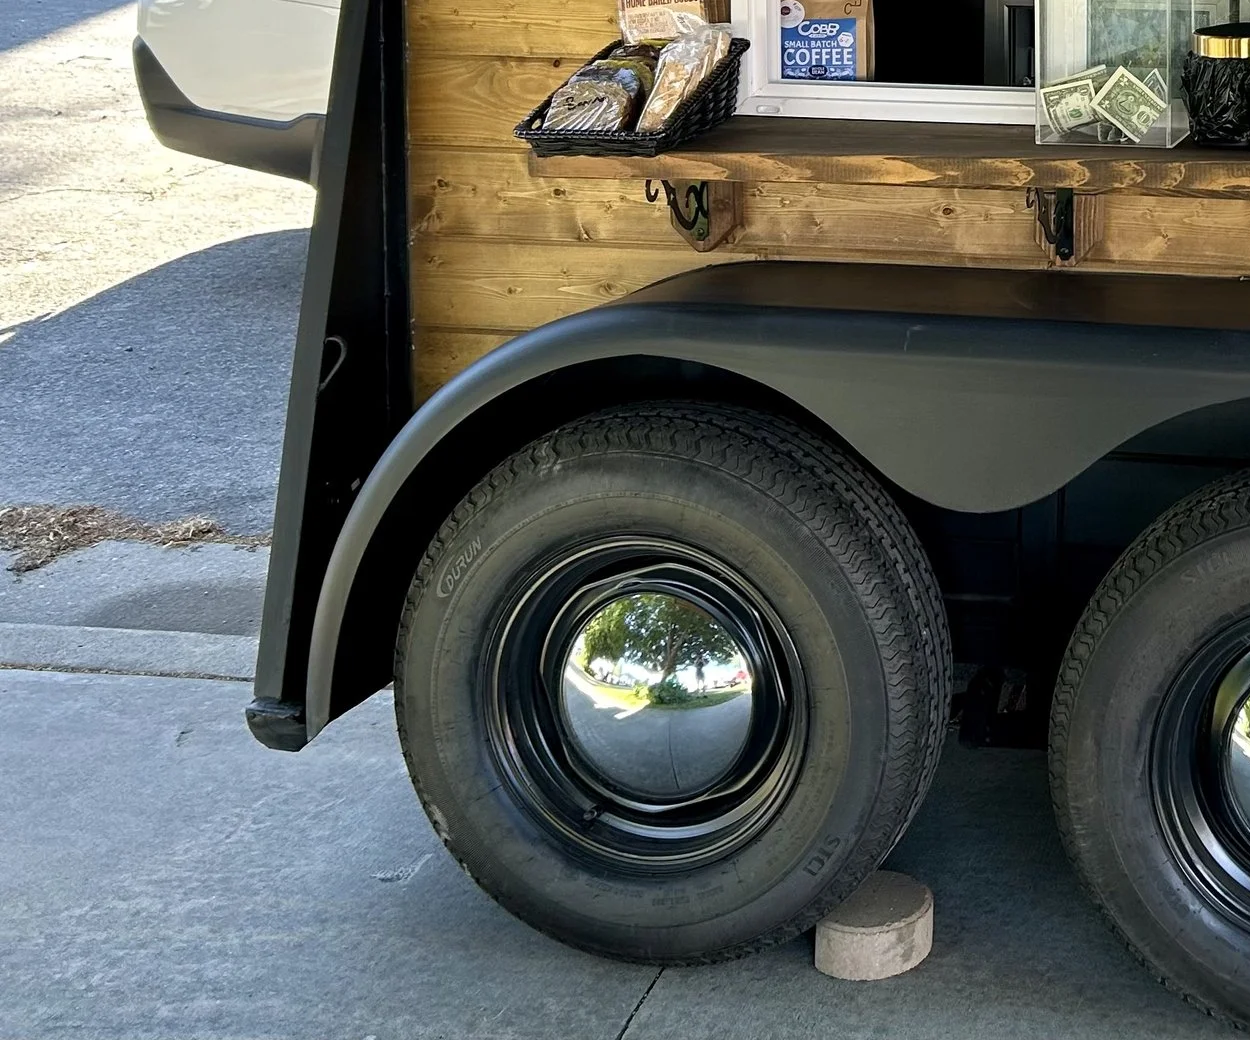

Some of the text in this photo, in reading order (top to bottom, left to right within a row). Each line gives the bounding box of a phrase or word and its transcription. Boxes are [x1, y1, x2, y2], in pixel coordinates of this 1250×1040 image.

[798, 21, 839, 36] COBB
[784, 49, 853, 65] COFFEE
[446, 536, 481, 592] DURUN
